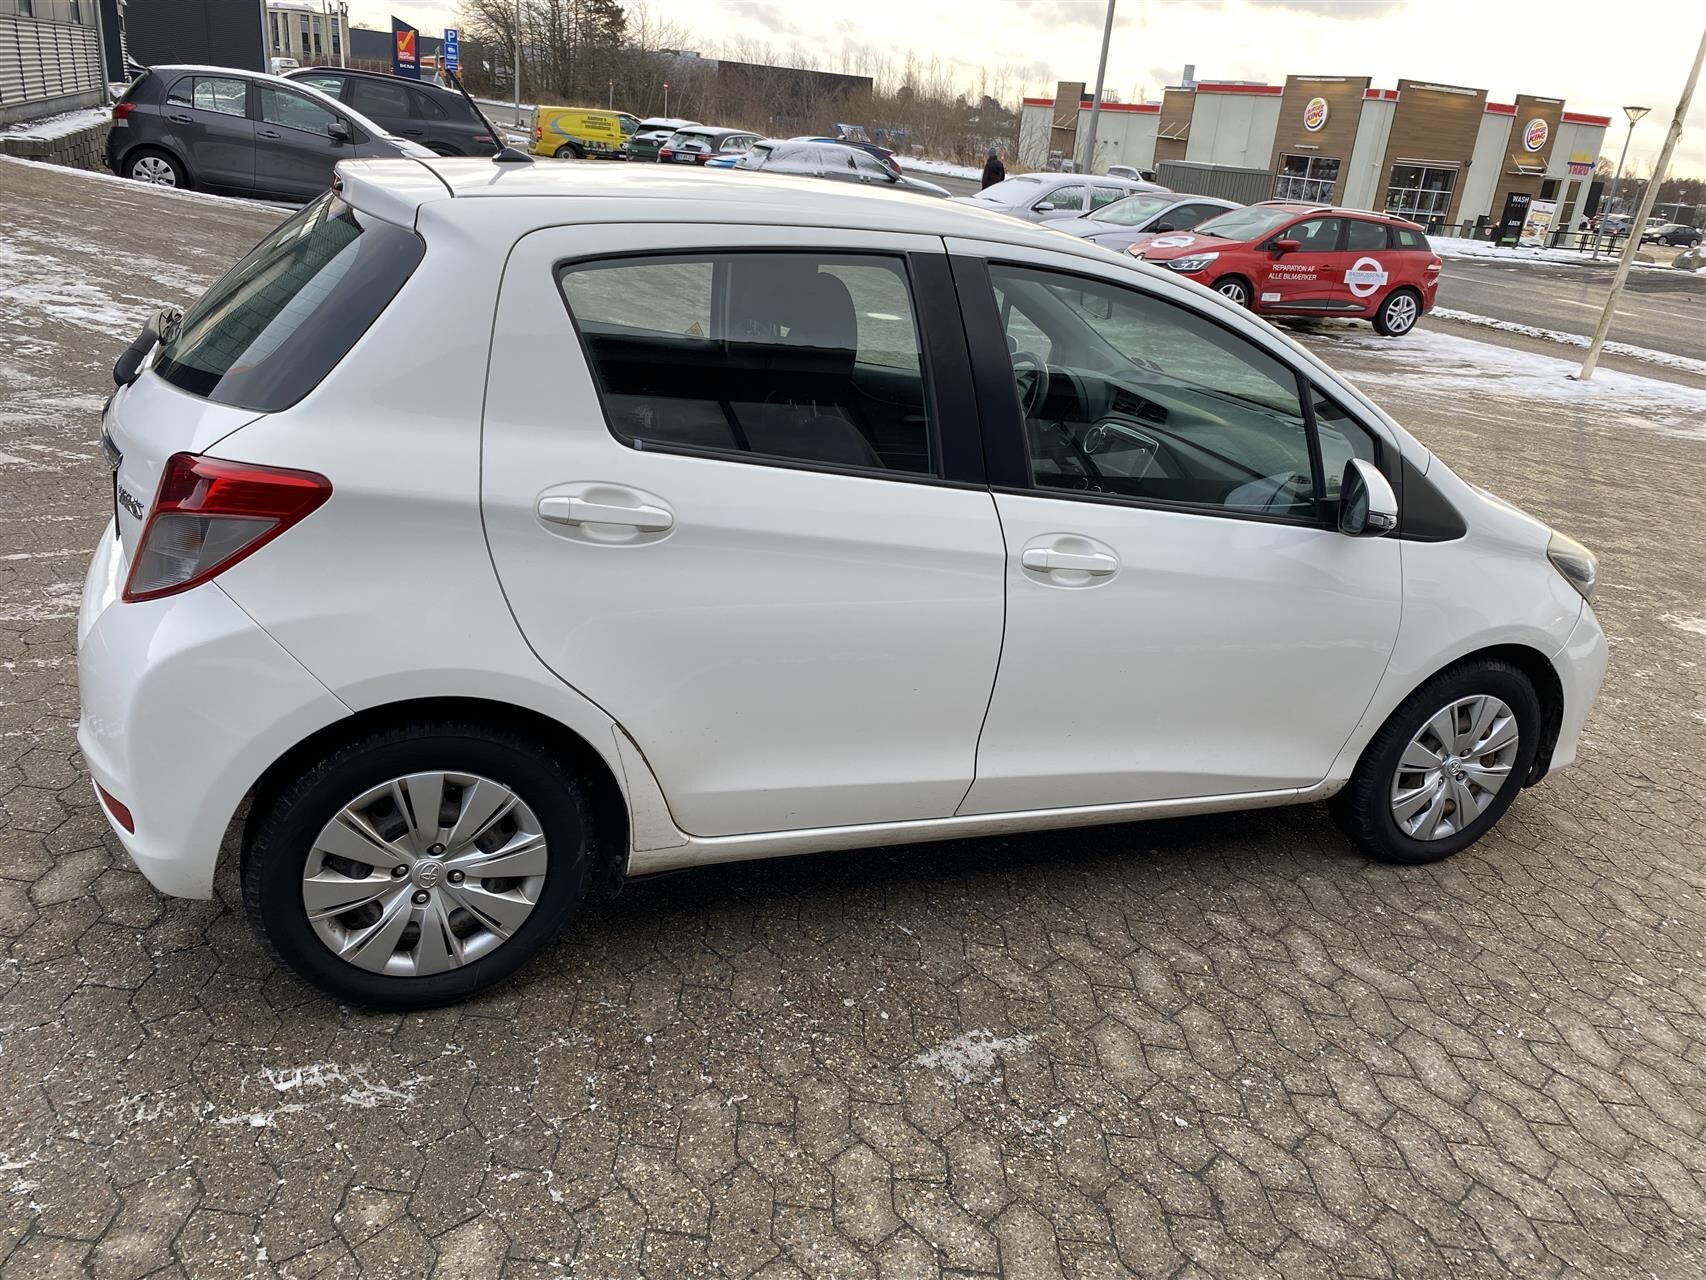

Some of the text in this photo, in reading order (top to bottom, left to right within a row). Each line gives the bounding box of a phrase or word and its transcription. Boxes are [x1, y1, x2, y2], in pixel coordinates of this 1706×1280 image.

[447, 31, 455, 41] P
[1528, 131, 1546, 143] KING
[1568, 165, 1589, 176] THRU
[1512, 195, 1530, 203] WASH
[1272, 264, 1307, 272] REPARATION
[1268, 272, 1283, 280] ALLE
